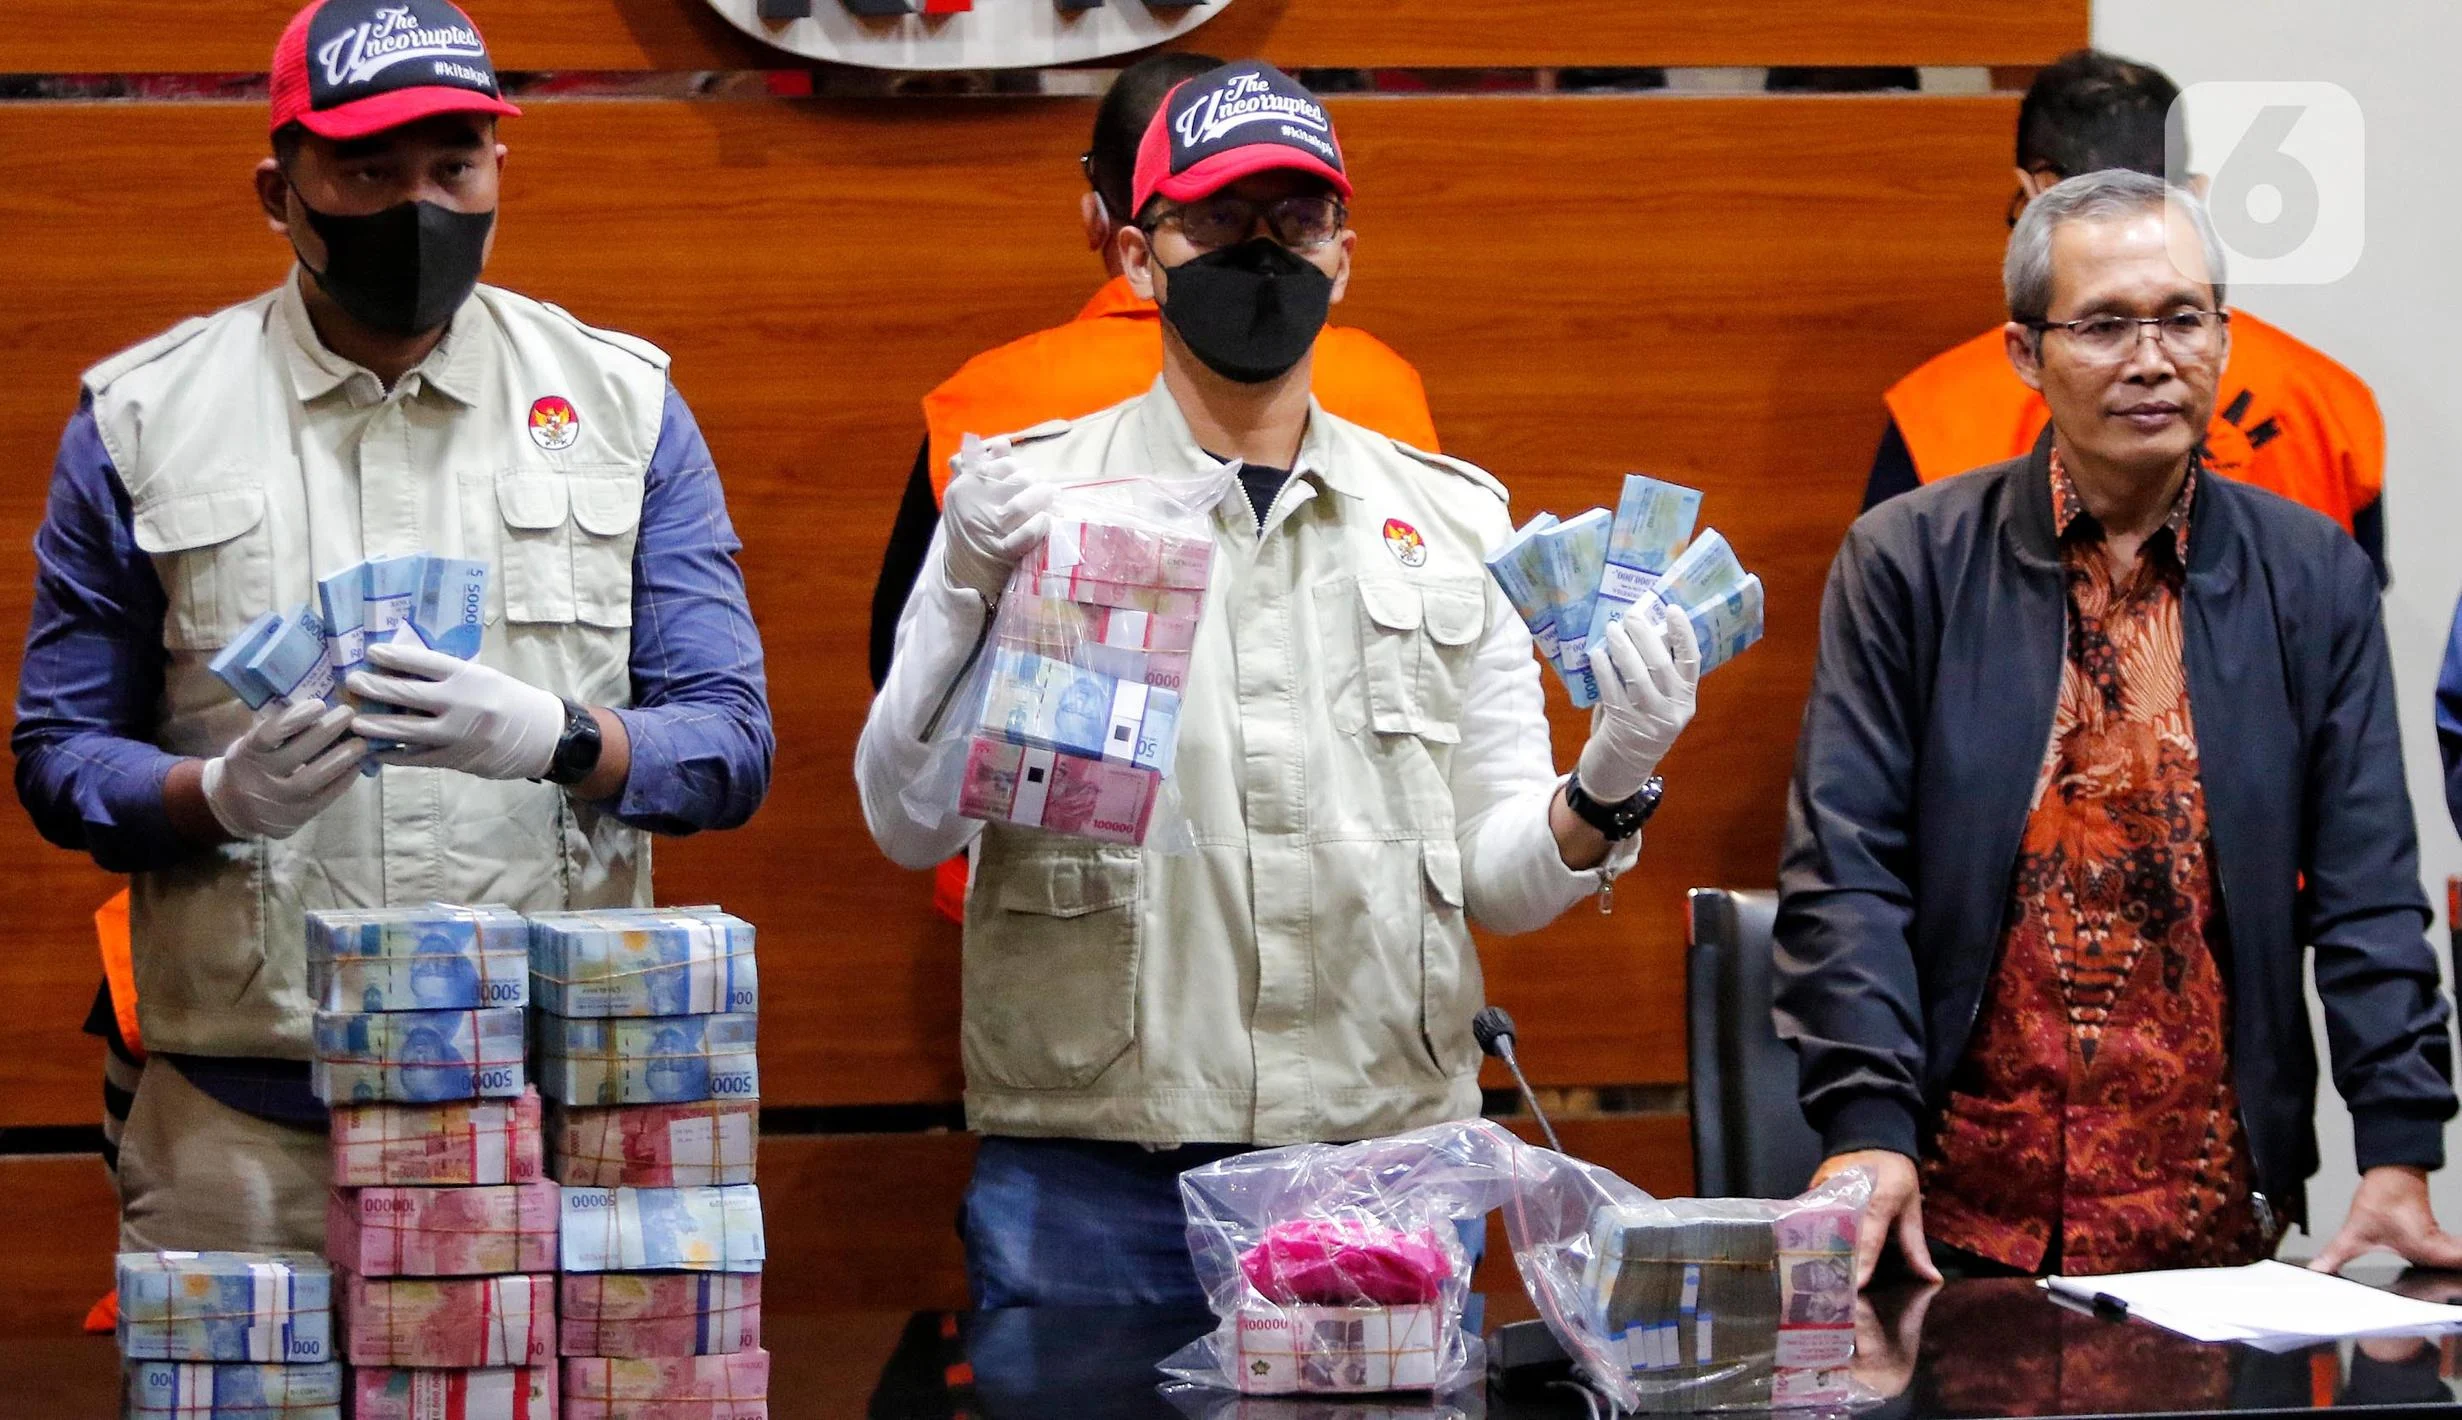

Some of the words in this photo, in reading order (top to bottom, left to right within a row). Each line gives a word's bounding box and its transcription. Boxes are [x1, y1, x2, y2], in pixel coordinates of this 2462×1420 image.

[373, 5, 419, 39] The
[318, 22, 480, 87] Uncorrupted
[433, 61, 492, 87] #kitakpk
[1225, 71, 1270, 102] The
[1175, 88, 1325, 148] Uncorrupted
[1280, 124, 1335, 157] #kitakpk
[1093, 819, 1134, 834] 100000
